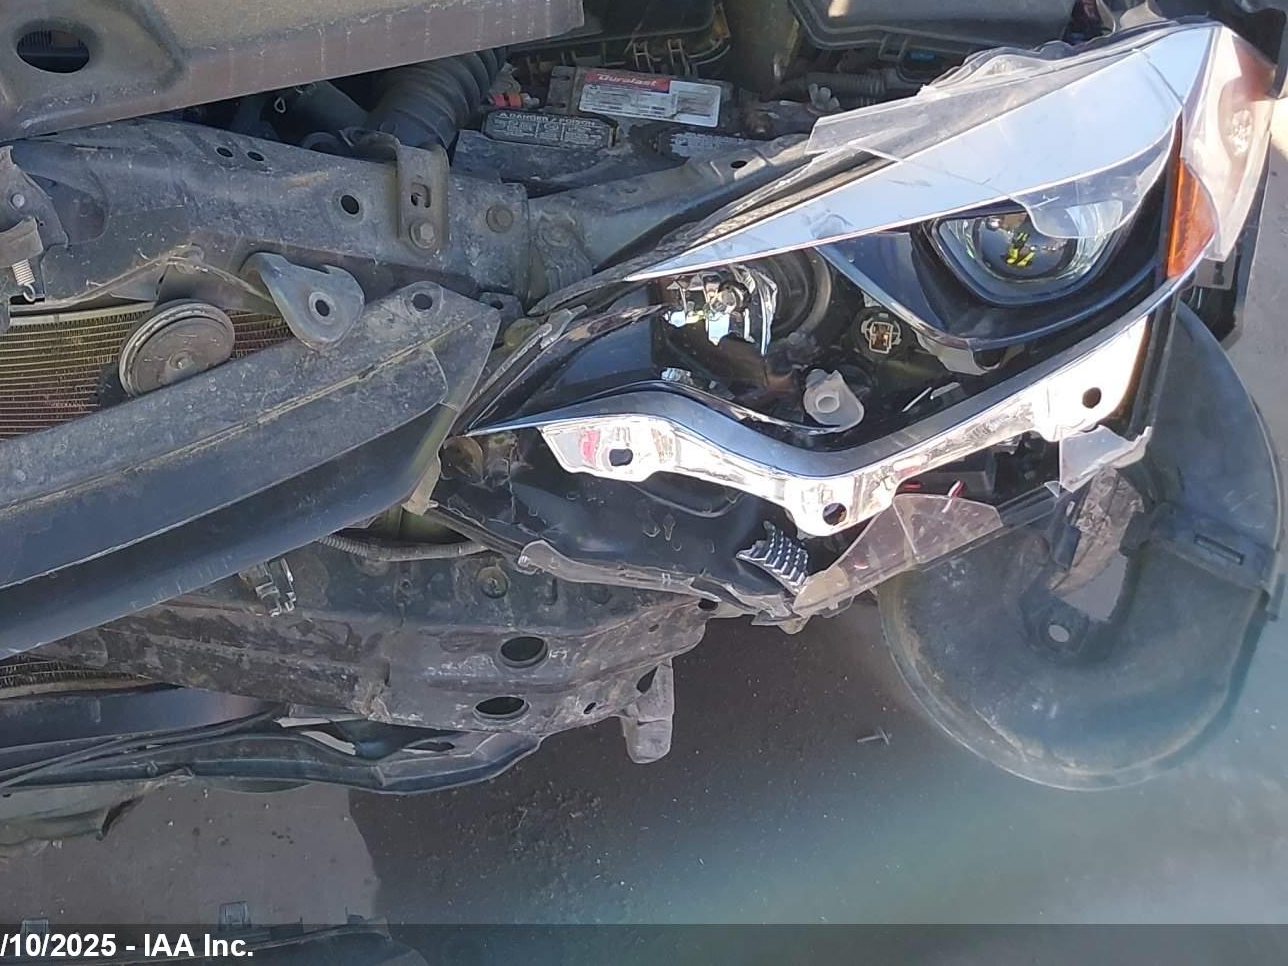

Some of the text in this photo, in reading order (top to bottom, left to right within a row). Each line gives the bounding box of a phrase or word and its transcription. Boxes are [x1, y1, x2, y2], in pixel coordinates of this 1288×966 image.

[597, 73, 658, 87] Duralast
[509, 114, 550, 124] DANGER
[559, 117, 596, 127] POISON
